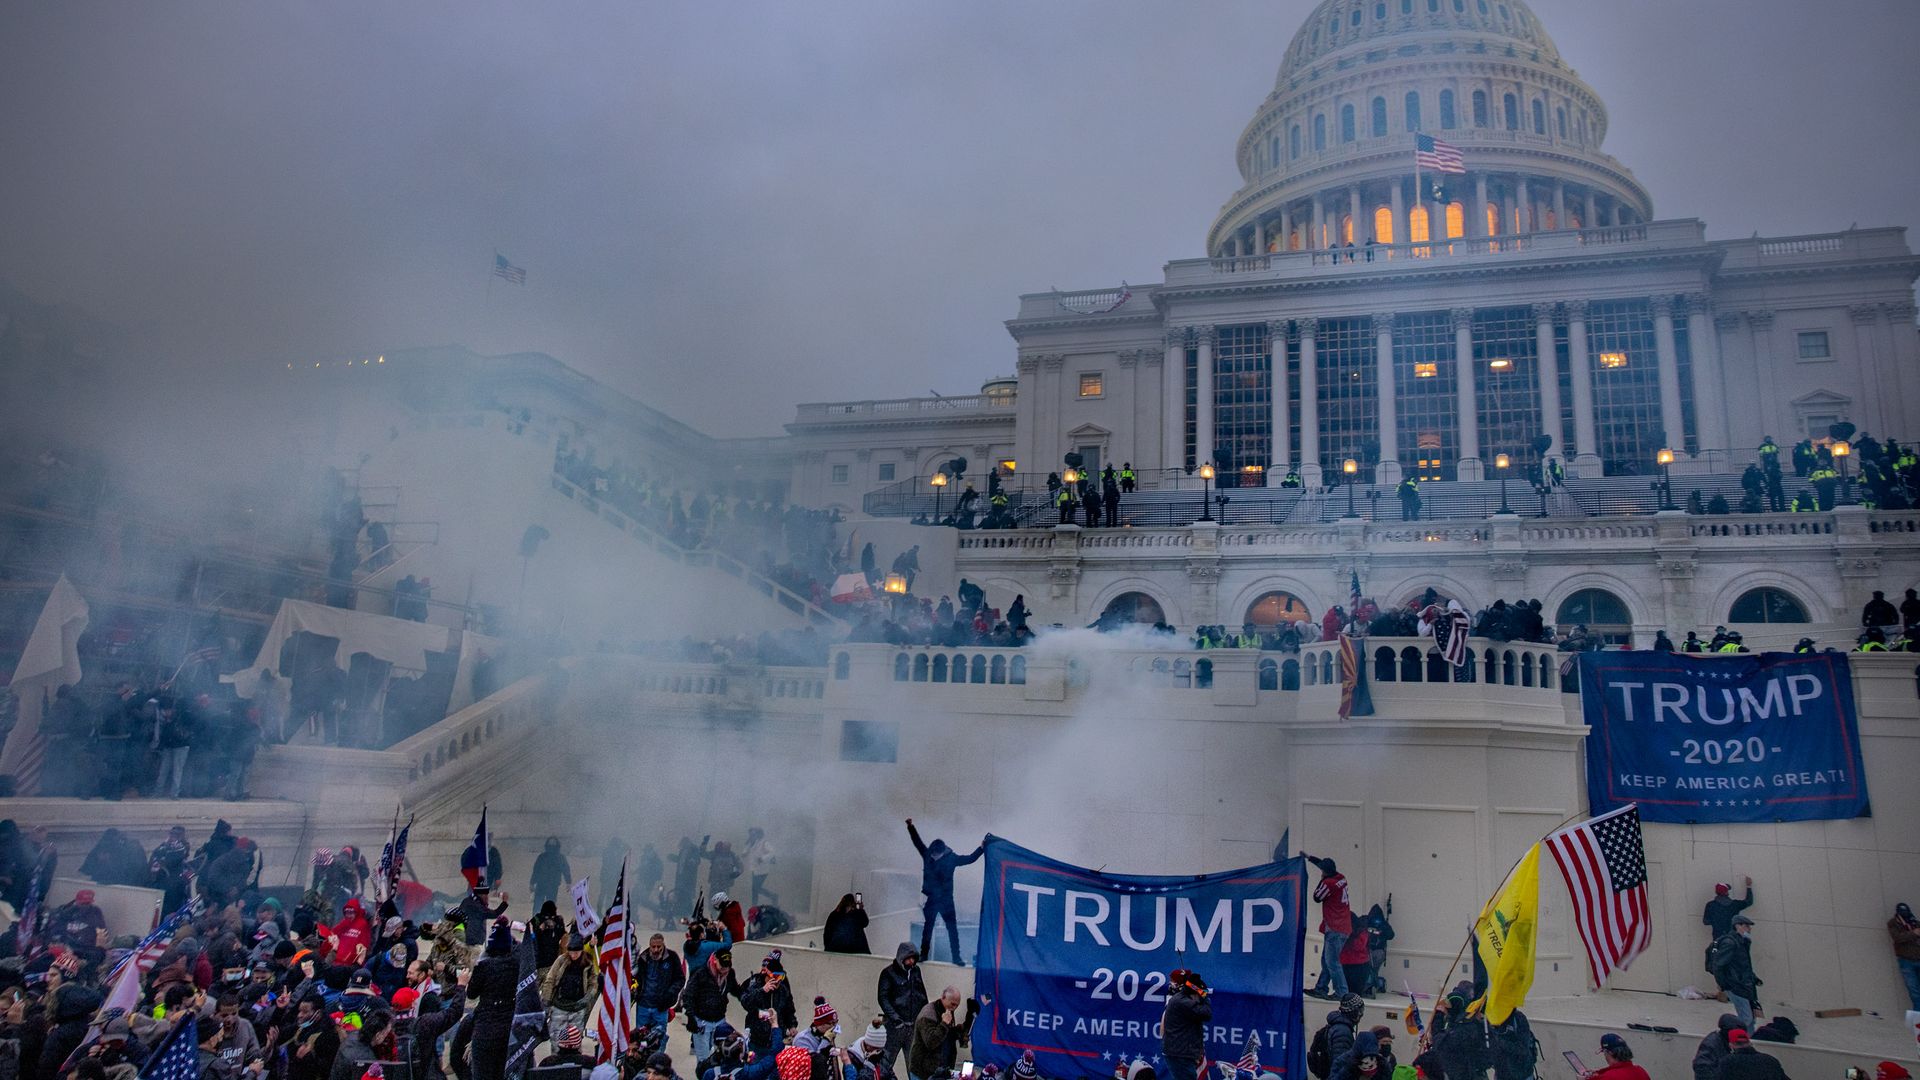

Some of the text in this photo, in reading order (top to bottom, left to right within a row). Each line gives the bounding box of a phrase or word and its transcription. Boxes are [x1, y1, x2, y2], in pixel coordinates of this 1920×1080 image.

[1608, 673, 1823, 726] TRUMP
[1670, 736, 1782, 765] -2020-
[1620, 769, 1845, 790] KEEP AMERICA GREAT!
[1012, 882, 1284, 953] TRUMP
[1075, 967, 1214, 1002] -202-
[1006, 1008, 1065, 1031] KEEP
[1073, 1017, 1164, 1040] AMERIC
